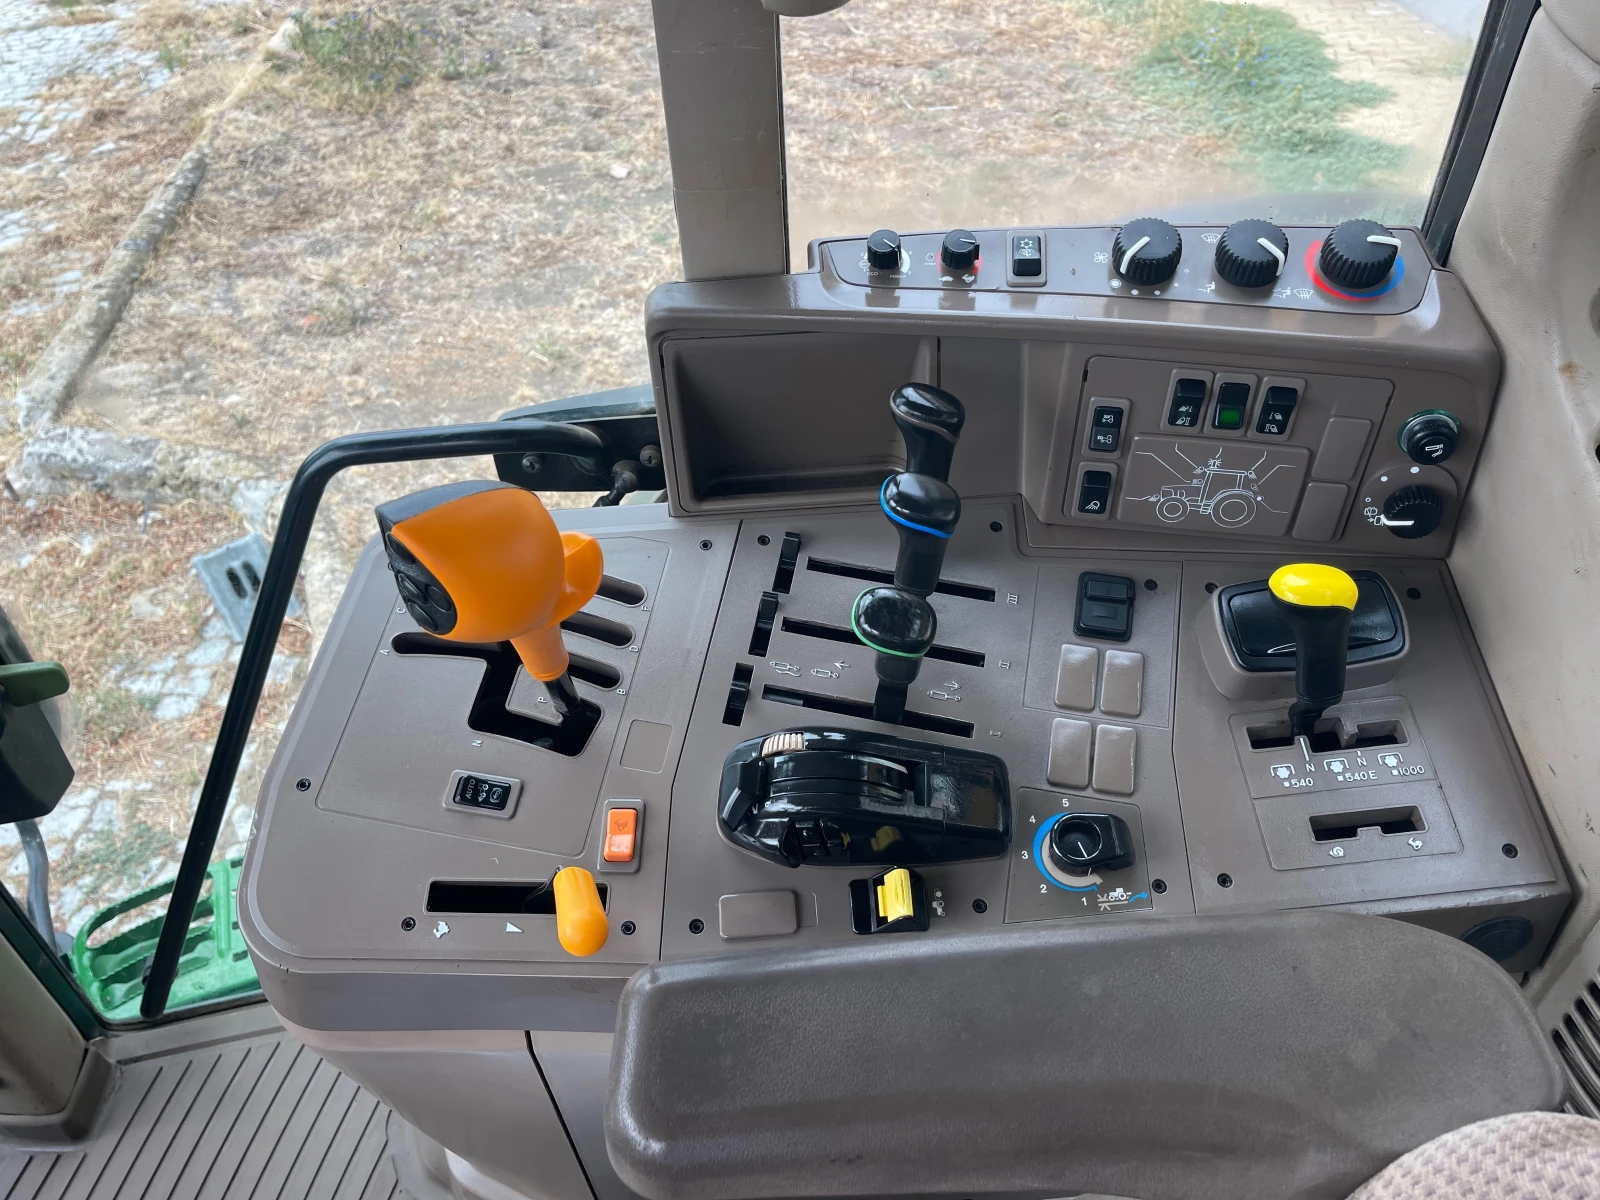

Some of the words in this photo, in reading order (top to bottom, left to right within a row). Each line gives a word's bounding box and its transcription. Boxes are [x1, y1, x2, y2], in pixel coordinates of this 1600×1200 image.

[1358, 758, 1368, 766] N
[1306, 764, 1316, 772] N
[1399, 765, 1425, 776] 1000
[1291, 778, 1314, 788] 540
[465, 779, 476, 799] AUTO
[1062, 798, 1070, 807] 5
[1029, 815, 1036, 824] 4
[1022, 850, 1029, 860] 3
[1040, 884, 1048, 894] 2
[1081, 897, 1087, 906] 1
